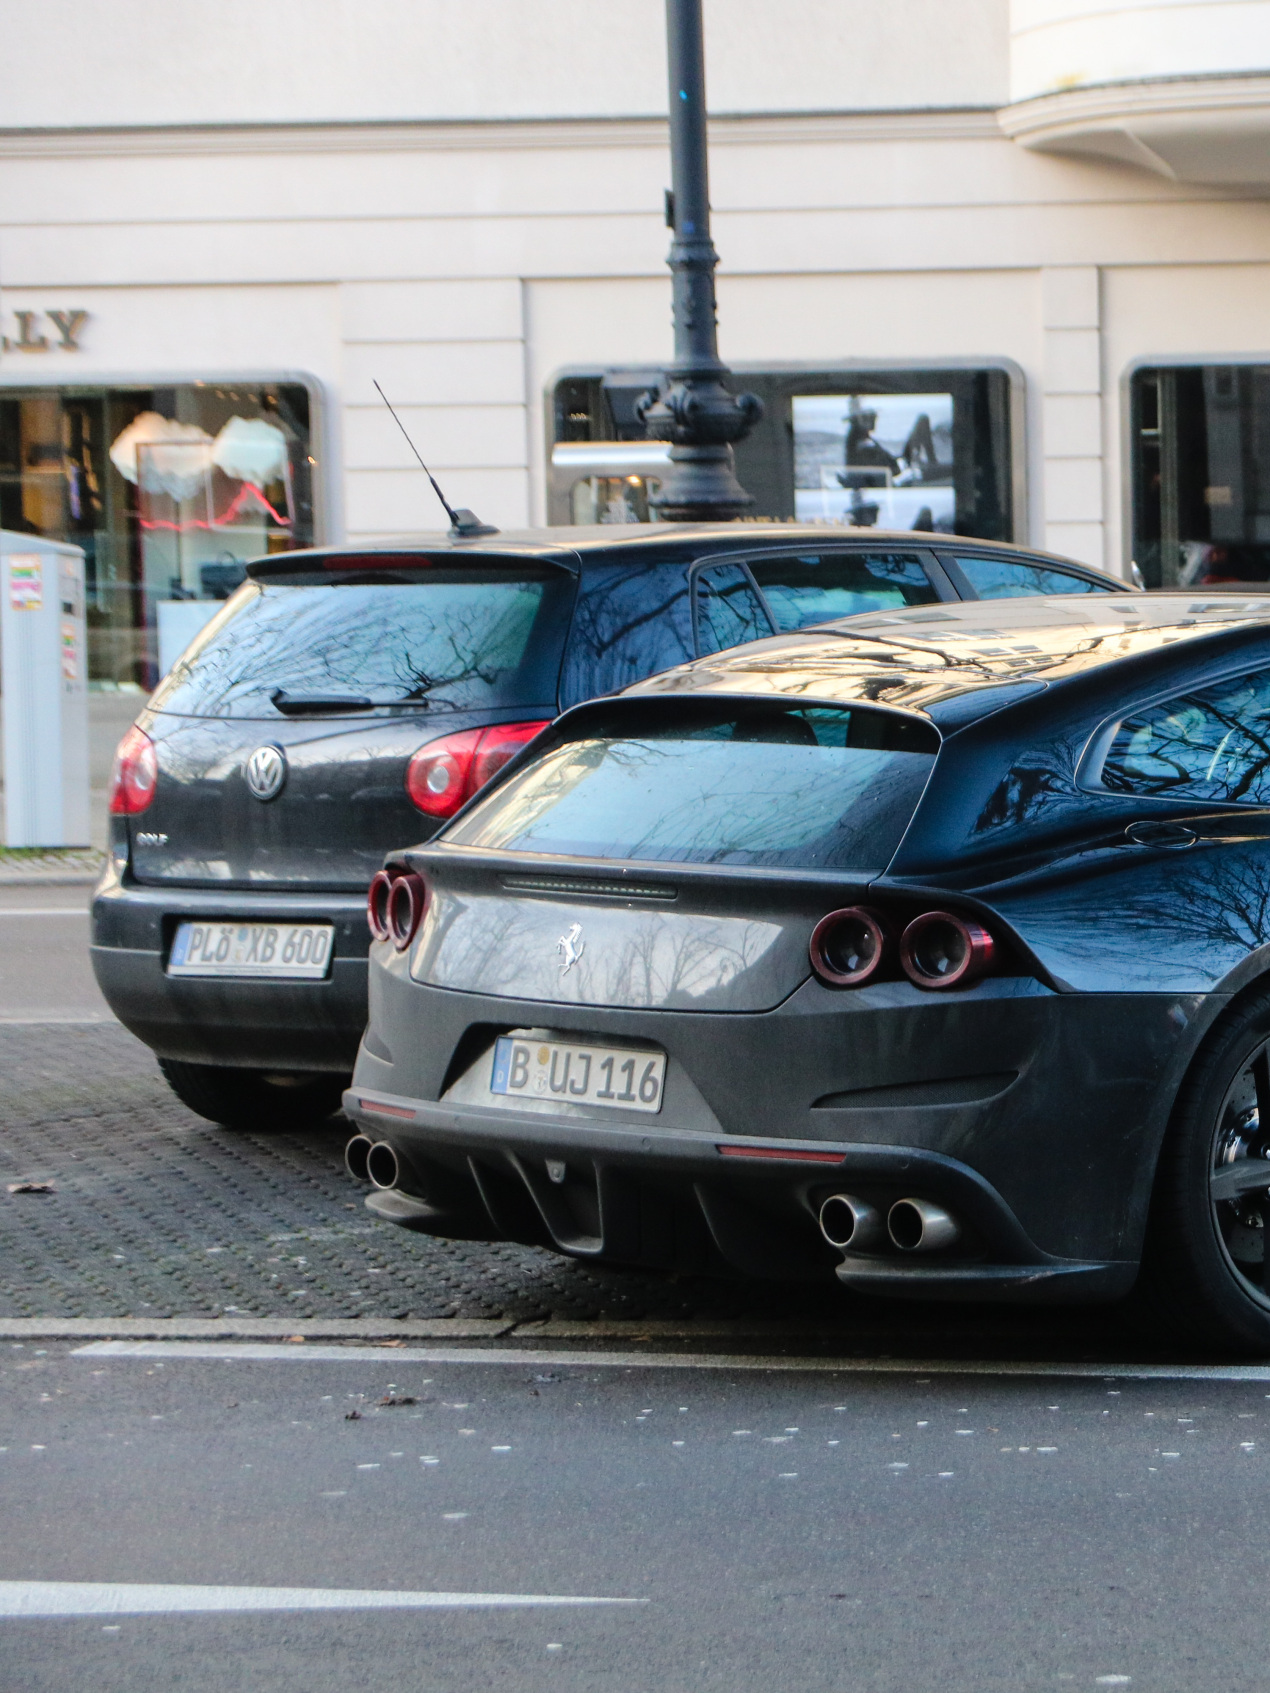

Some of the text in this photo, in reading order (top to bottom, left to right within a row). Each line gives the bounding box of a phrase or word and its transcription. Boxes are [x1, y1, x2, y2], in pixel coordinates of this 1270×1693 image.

[1, 309, 89, 354] LY
[187, 927, 330, 965] PLÖ XB 600
[509, 1045, 659, 1103] B UJ 116
